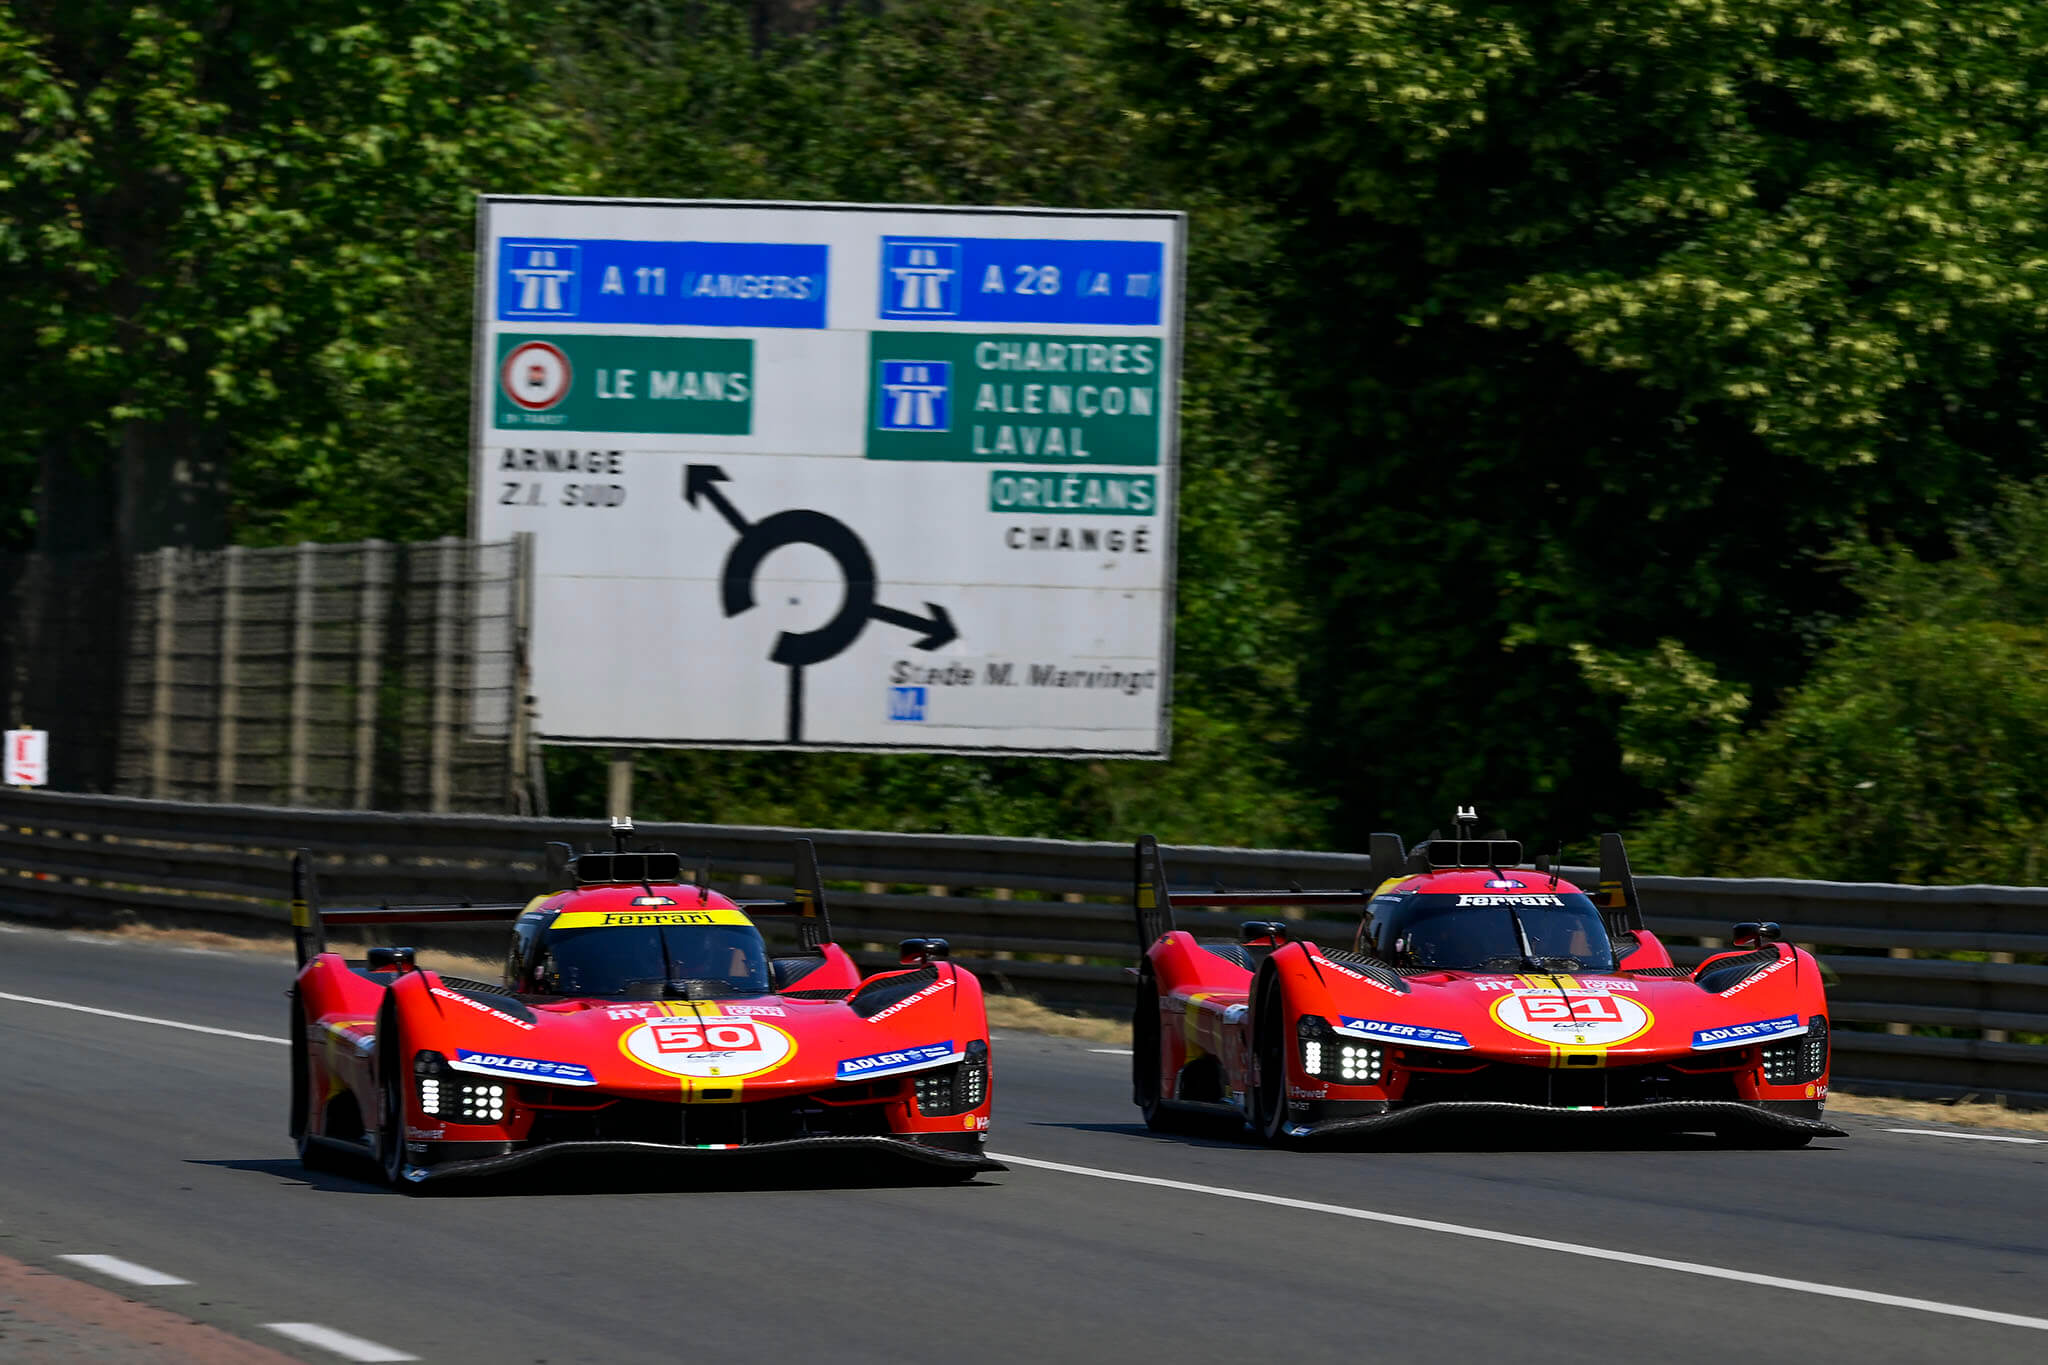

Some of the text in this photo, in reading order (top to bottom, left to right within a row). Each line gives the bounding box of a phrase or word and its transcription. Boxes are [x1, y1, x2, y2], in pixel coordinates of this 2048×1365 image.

[600, 266, 624, 295] A
[634, 267, 665, 296] 11
[980, 264, 1006, 294] A
[1014, 265, 1061, 295] 28
[974, 340, 1153, 375] CHARTRES
[594, 368, 749, 402] LE MANS
[972, 382, 1153, 418] ALENÇON
[971, 424, 1091, 457] LAVAL
[500, 447, 624, 475] ARNAGE
[561, 483, 626, 508] SUD
[993, 473, 1152, 510] ORLÉANS
[1003, 524, 1151, 554] CHANGÉ
[1455, 893, 1565, 907] Ferrari
[599, 911, 717, 926] Ferrari
[1364, 977, 1406, 998] MILLE
[1719, 956, 1796, 999] RICHARD MILLE
[867, 978, 957, 1024] RICHARD MILLE
[1524, 998, 1617, 1019] 51
[489, 1010, 537, 1031] MILLE
[1345, 1019, 1418, 1036] ADLER
[655, 1026, 755, 1051] 50
[1699, 1025, 1758, 1043] ADLER
[461, 1054, 539, 1071] ADLER
[842, 1052, 909, 1073] ADLER
